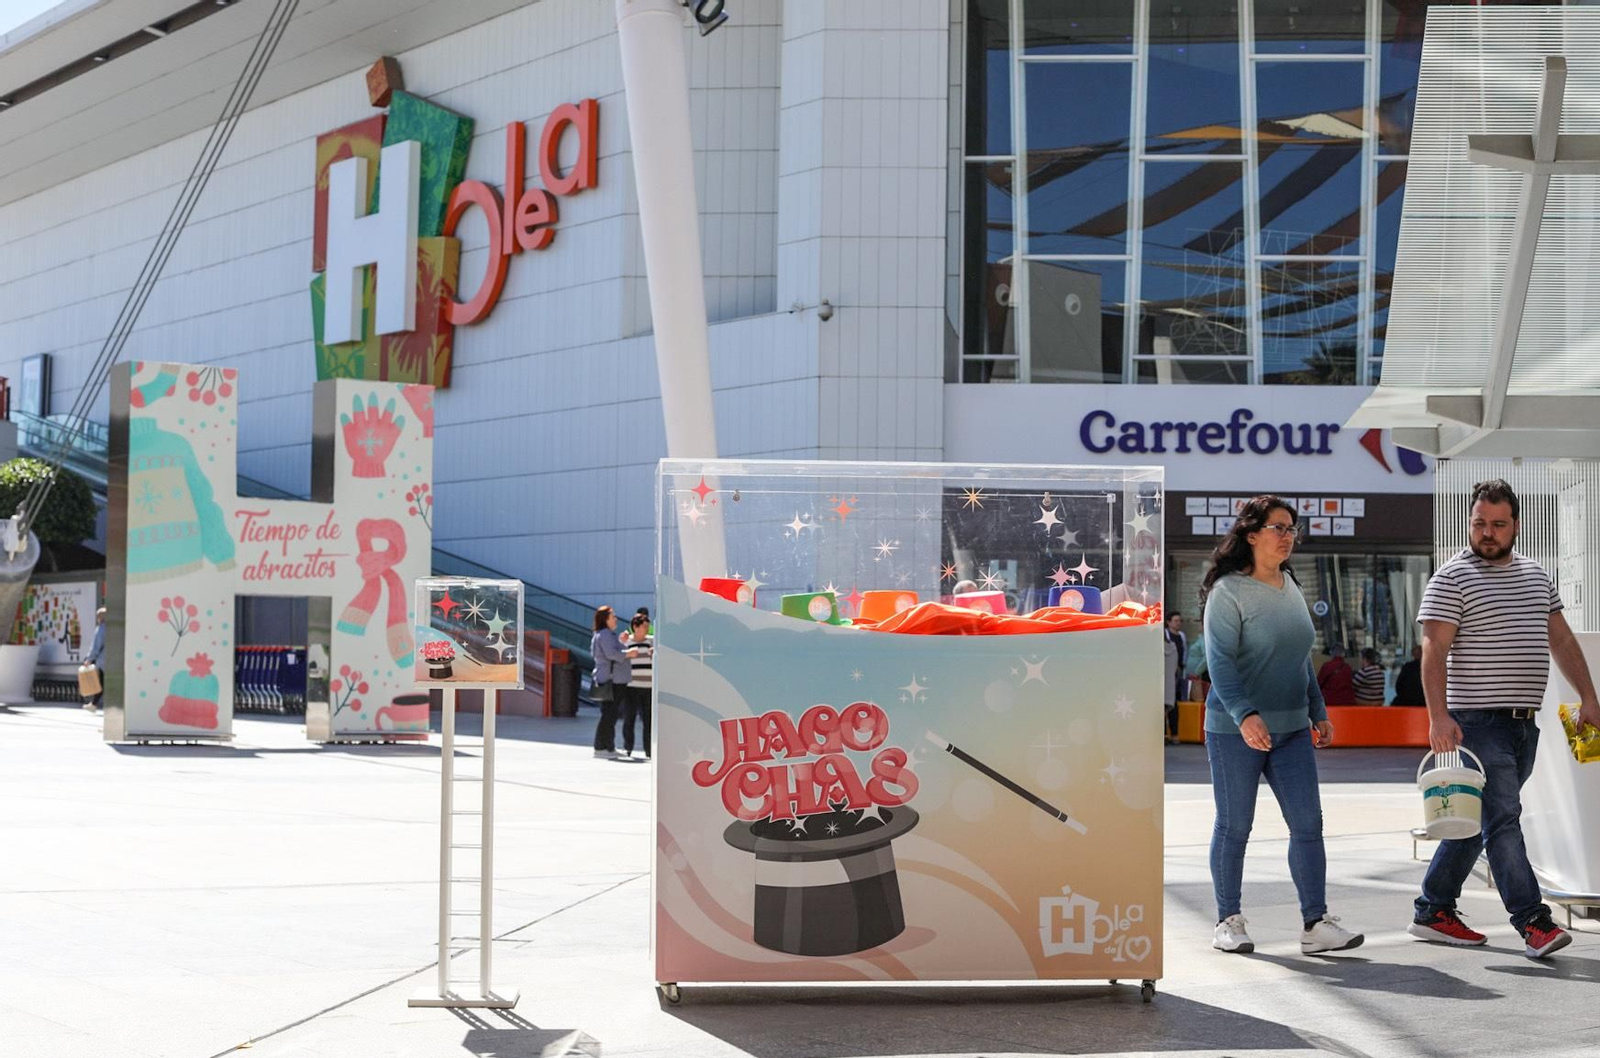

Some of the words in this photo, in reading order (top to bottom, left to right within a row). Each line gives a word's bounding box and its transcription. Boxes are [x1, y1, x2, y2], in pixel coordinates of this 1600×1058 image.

[1079, 408, 1341, 455] Carrefour
[234, 508, 311, 557] Tiempo
[315, 508, 341, 540] de
[242, 547, 350, 581] abracitos
[691, 702, 890, 788] HAGO
[720, 747, 920, 822] CHAS
[1104, 946, 1116, 955] de
